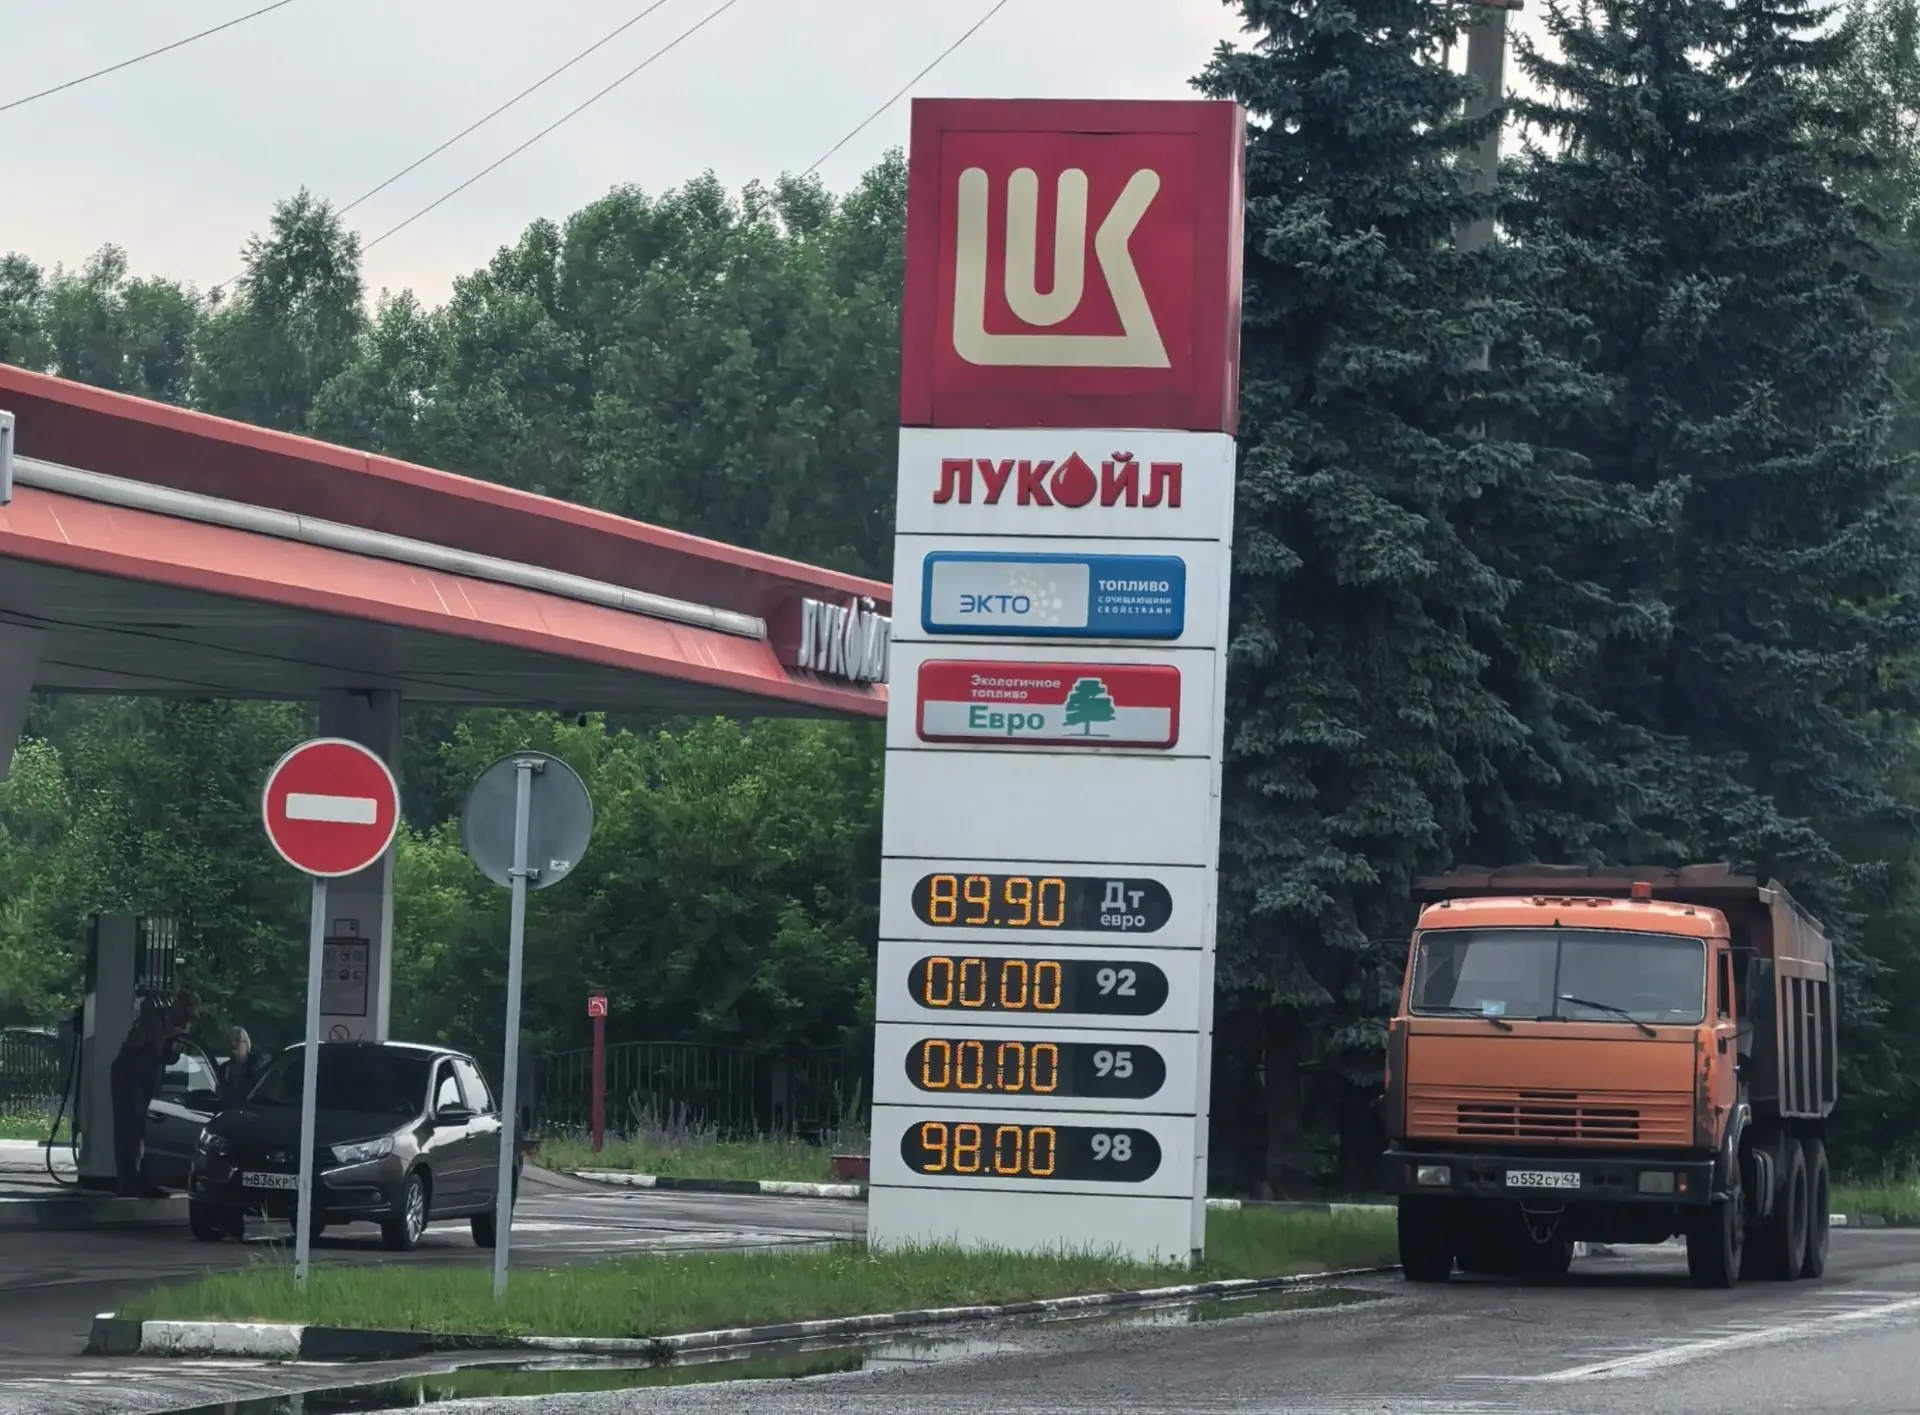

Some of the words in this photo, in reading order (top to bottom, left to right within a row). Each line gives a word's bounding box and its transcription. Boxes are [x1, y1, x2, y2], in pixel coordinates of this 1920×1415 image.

[933, 451, 1182, 508] ЛУКОЙЛ
[960, 594, 1030, 613] ЭКТО
[970, 674, 1061, 688] Экологичное
[970, 689, 1028, 699] топливо
[968, 705, 1045, 736] Евро
[929, 875, 1066, 927] 89.90
[1100, 913, 1146, 931] евро
[924, 957, 1062, 1010] 00.00
[1096, 968, 1136, 996] 92
[922, 1039, 1059, 1093] 00.00
[1093, 1050, 1133, 1078] 95
[920, 1122, 1057, 1176] 98.00
[1091, 1133, 1132, 1162] 98
